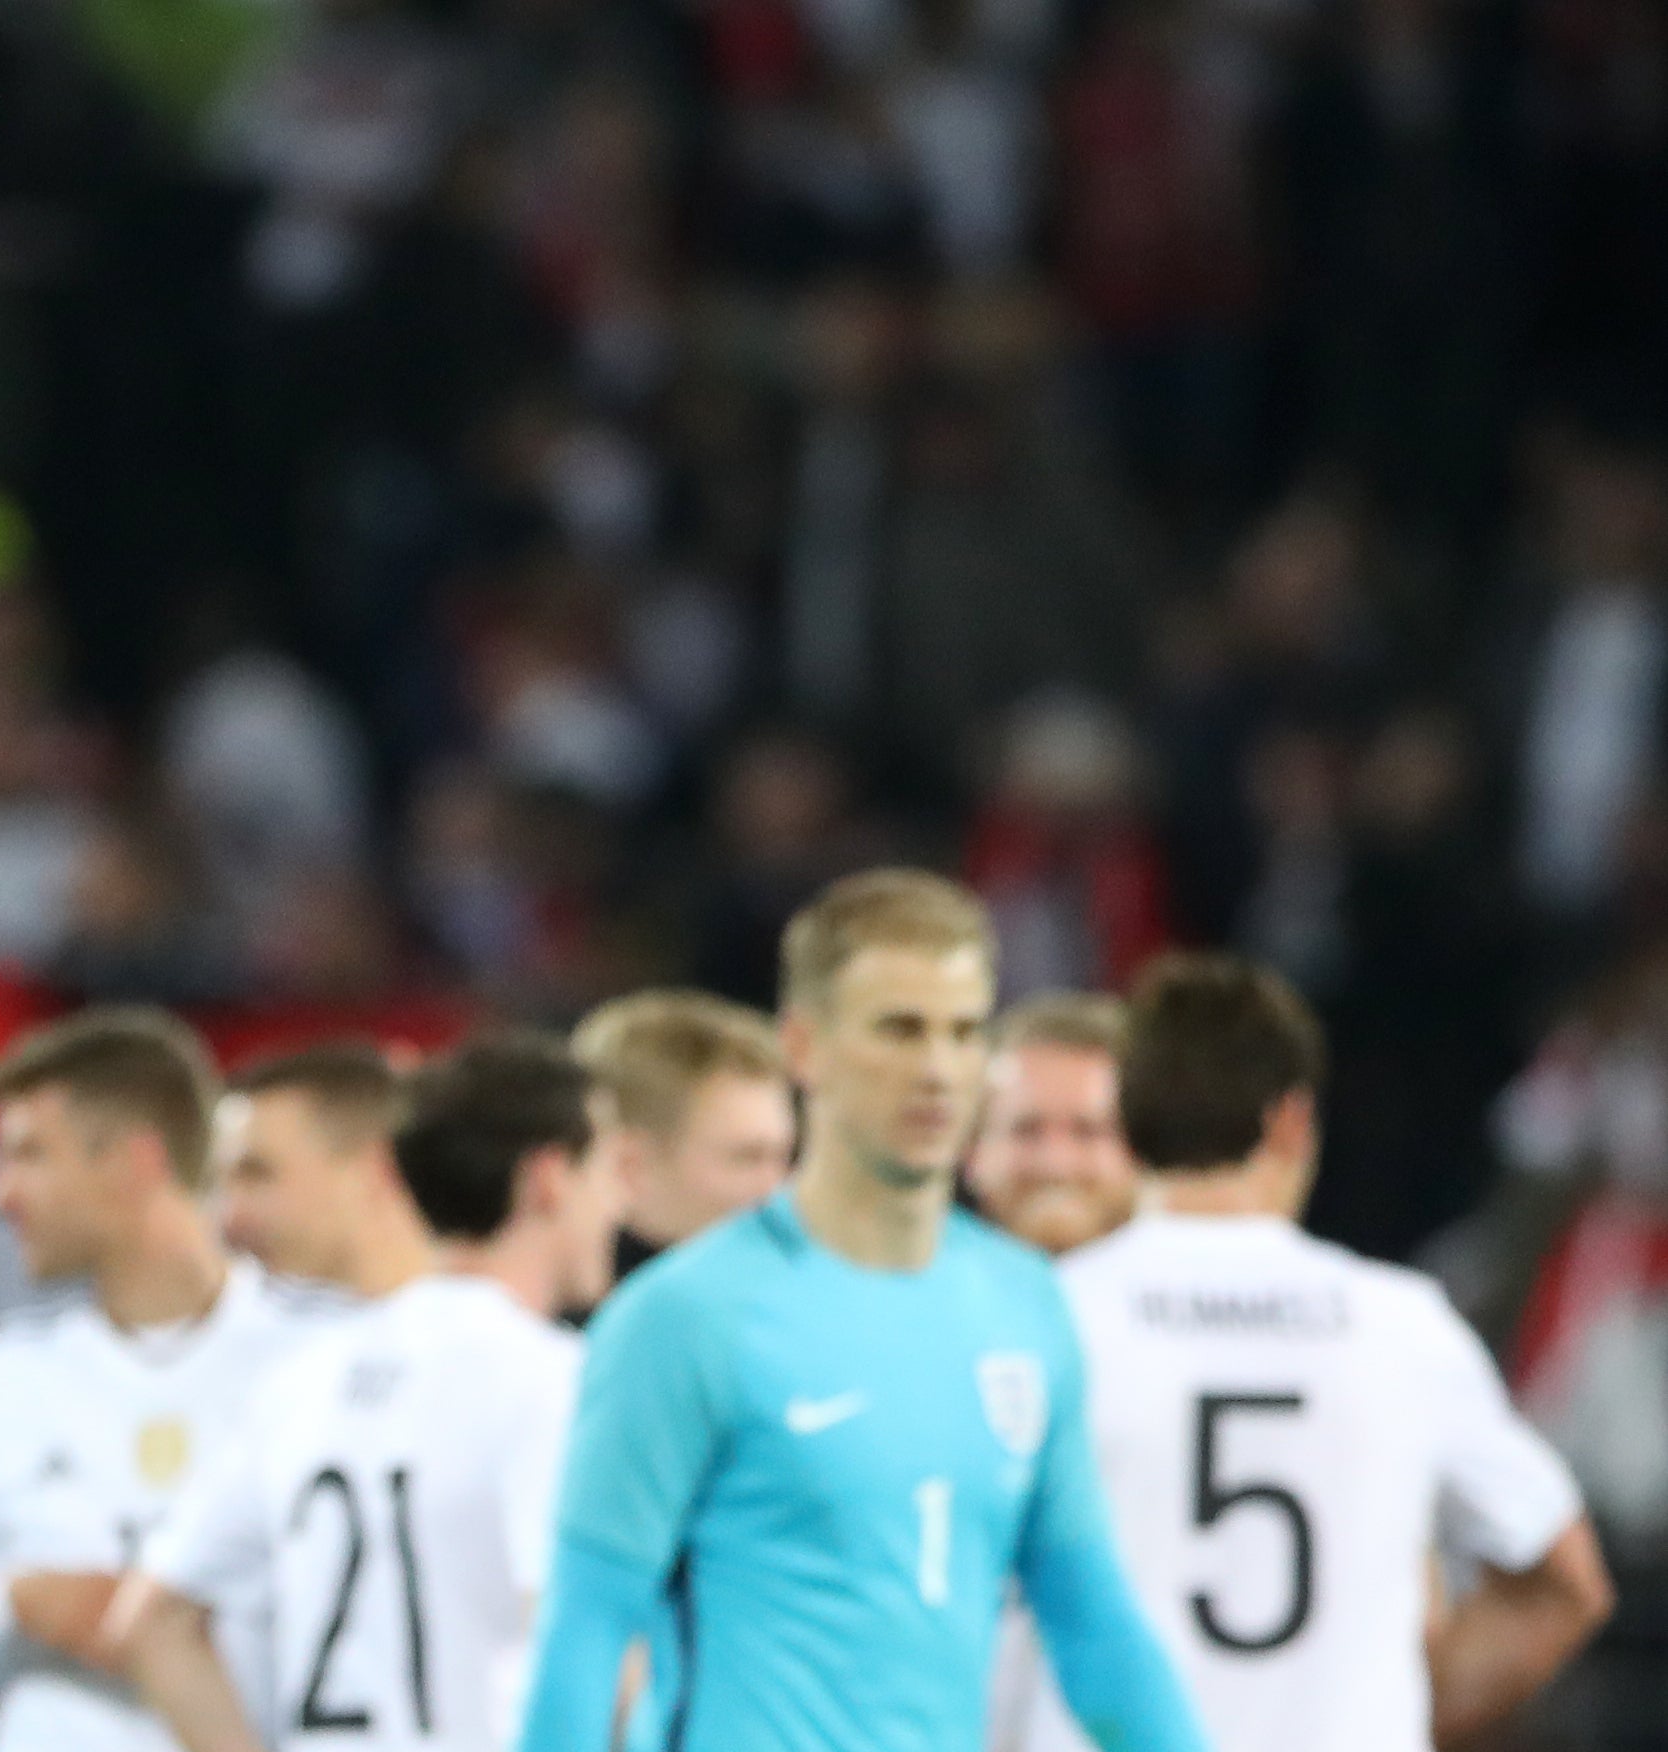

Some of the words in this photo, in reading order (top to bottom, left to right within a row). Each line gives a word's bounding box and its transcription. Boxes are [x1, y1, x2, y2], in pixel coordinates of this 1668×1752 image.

[289, 1464, 432, 1735] 21
[916, 1479, 950, 1606] 1
[1186, 1390, 1315, 1655] 5
